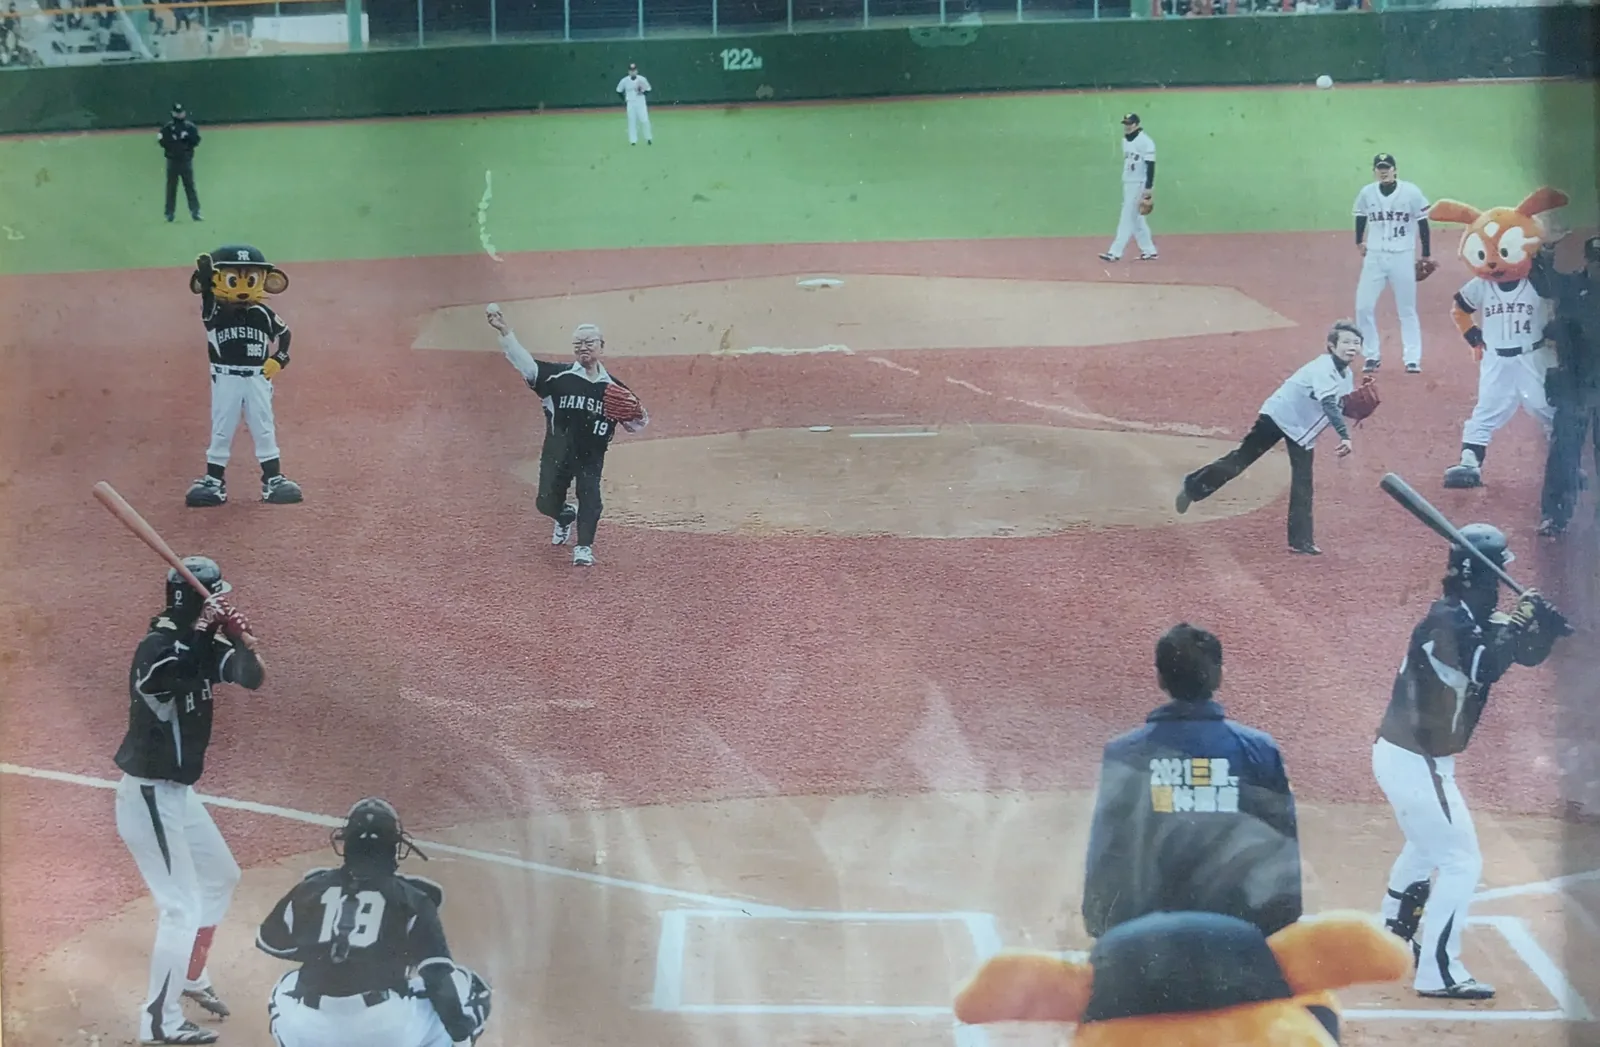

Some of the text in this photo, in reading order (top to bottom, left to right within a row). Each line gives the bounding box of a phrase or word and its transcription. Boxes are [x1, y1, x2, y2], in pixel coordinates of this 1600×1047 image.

[1393, 225, 1406, 238] 14
[1485, 303, 1534, 317] GIANTS
[1514, 320, 1532, 334] 14
[559, 395, 604, 415] HANSH
[593, 420, 609, 436] 19
